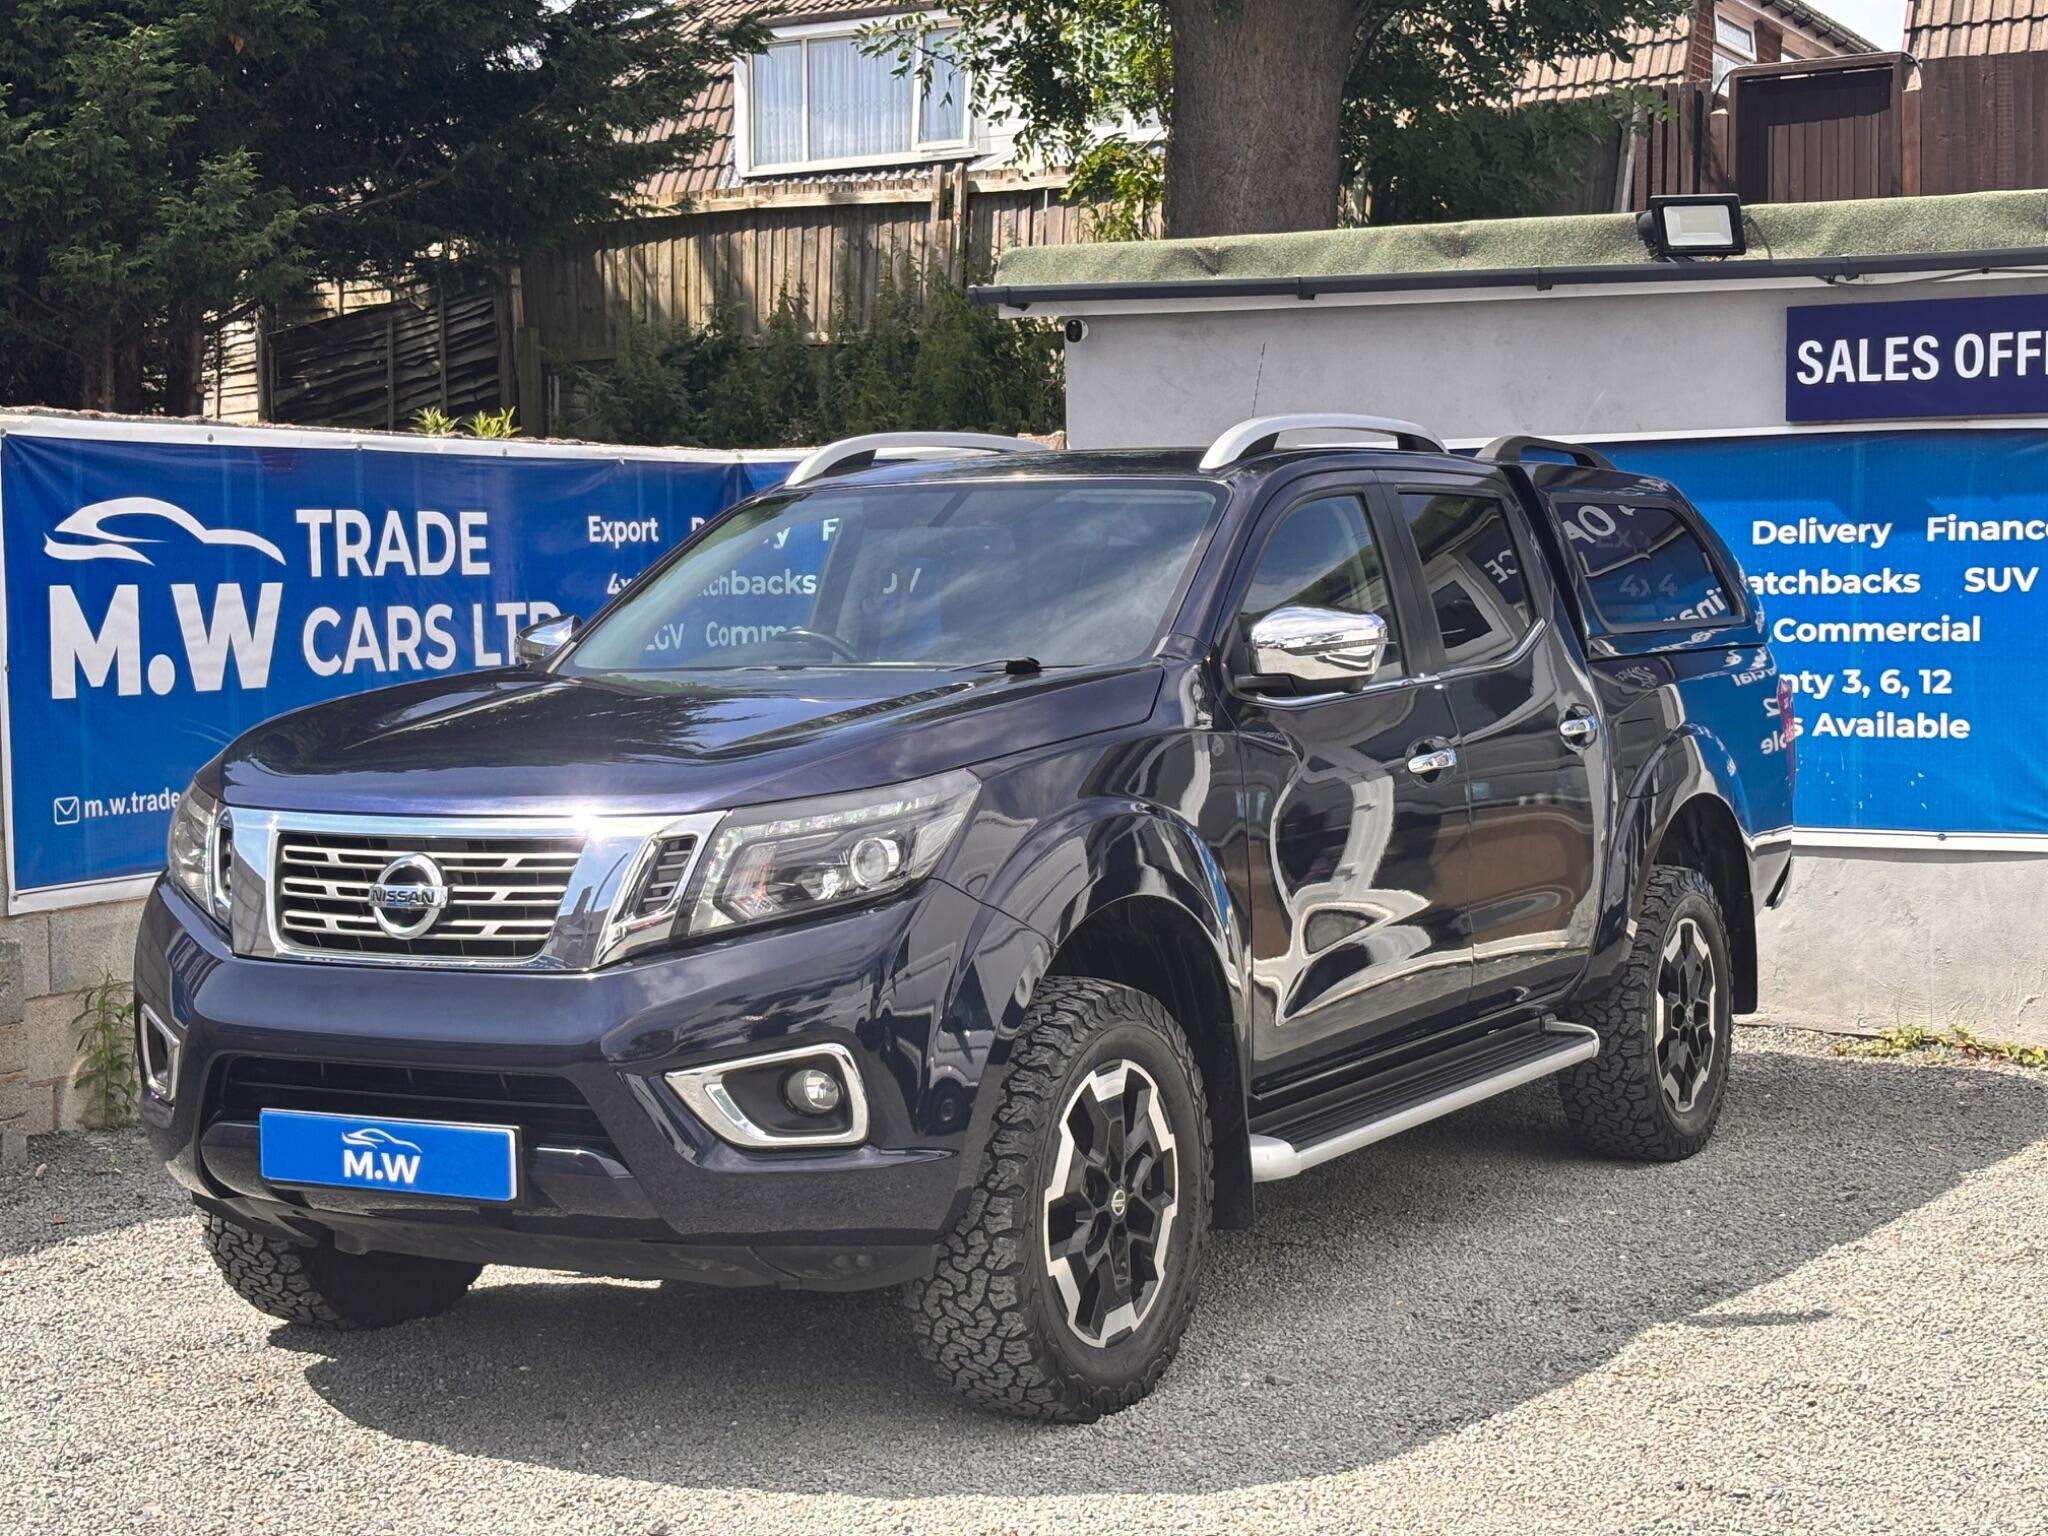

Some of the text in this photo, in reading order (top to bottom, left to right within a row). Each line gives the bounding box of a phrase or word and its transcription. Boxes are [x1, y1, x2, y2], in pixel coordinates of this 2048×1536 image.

[1796, 329, 2048, 386] SALES OFF
[295, 508, 491, 578] TRADE
[587, 515, 660, 549] Export
[1751, 513, 2048, 549] Delivery Financ
[1747, 566, 2040, 596] atchbacks SUV
[48, 581, 284, 700] M.W
[302, 602, 457, 677] CARS
[1772, 614, 1982, 644] Commercial
[1841, 668, 1871, 700] 3,
[1879, 668, 1911, 700] 6,
[1918, 668, 1953, 695] 12
[1811, 710, 1971, 739] Available
[370, 889, 435, 904] NISSAN
[342, 1149, 421, 1184] M.W
